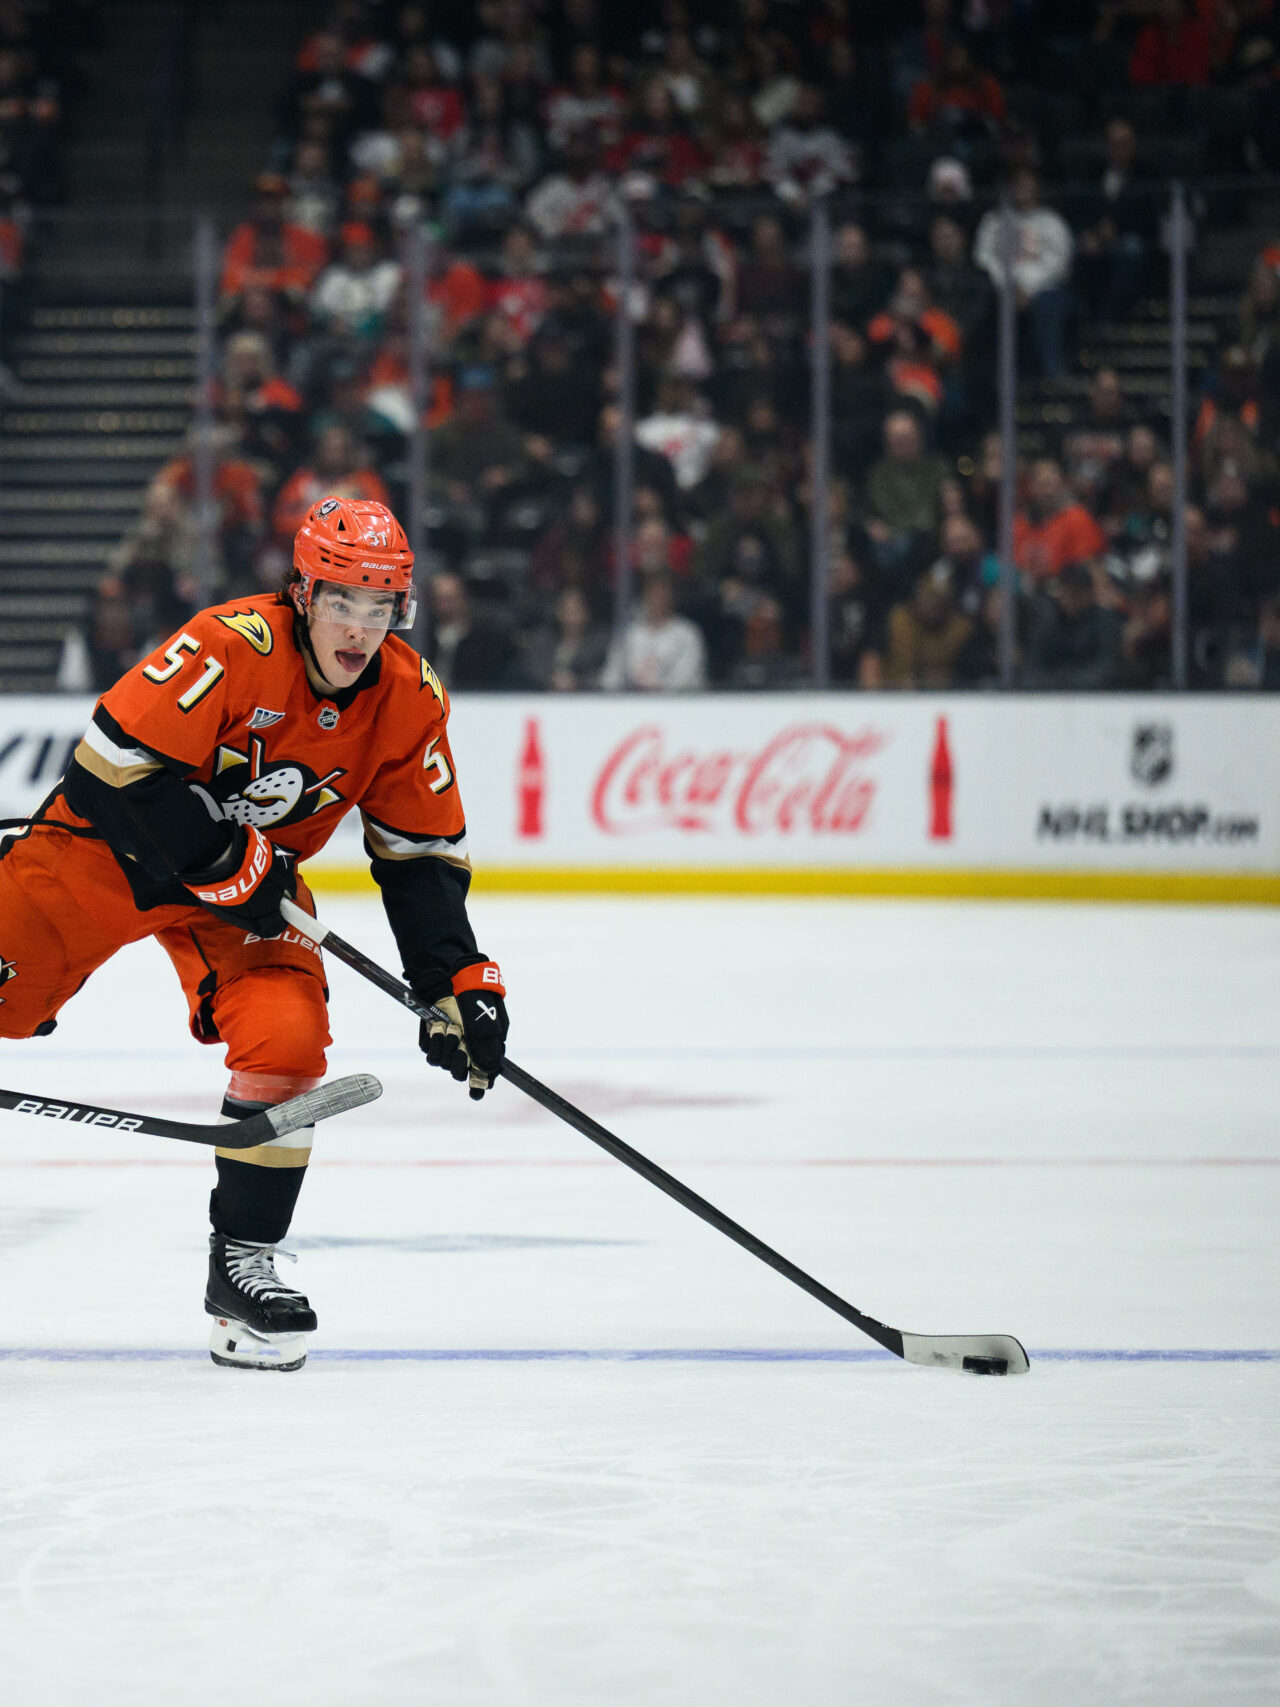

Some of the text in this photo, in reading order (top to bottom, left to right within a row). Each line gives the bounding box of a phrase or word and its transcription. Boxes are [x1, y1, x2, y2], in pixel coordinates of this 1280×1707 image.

[361, 561, 397, 571] BAUER
[142, 632, 225, 715] 51
[197, 827, 269, 902] BAUER
[14, 1099, 145, 1133] BAUER
